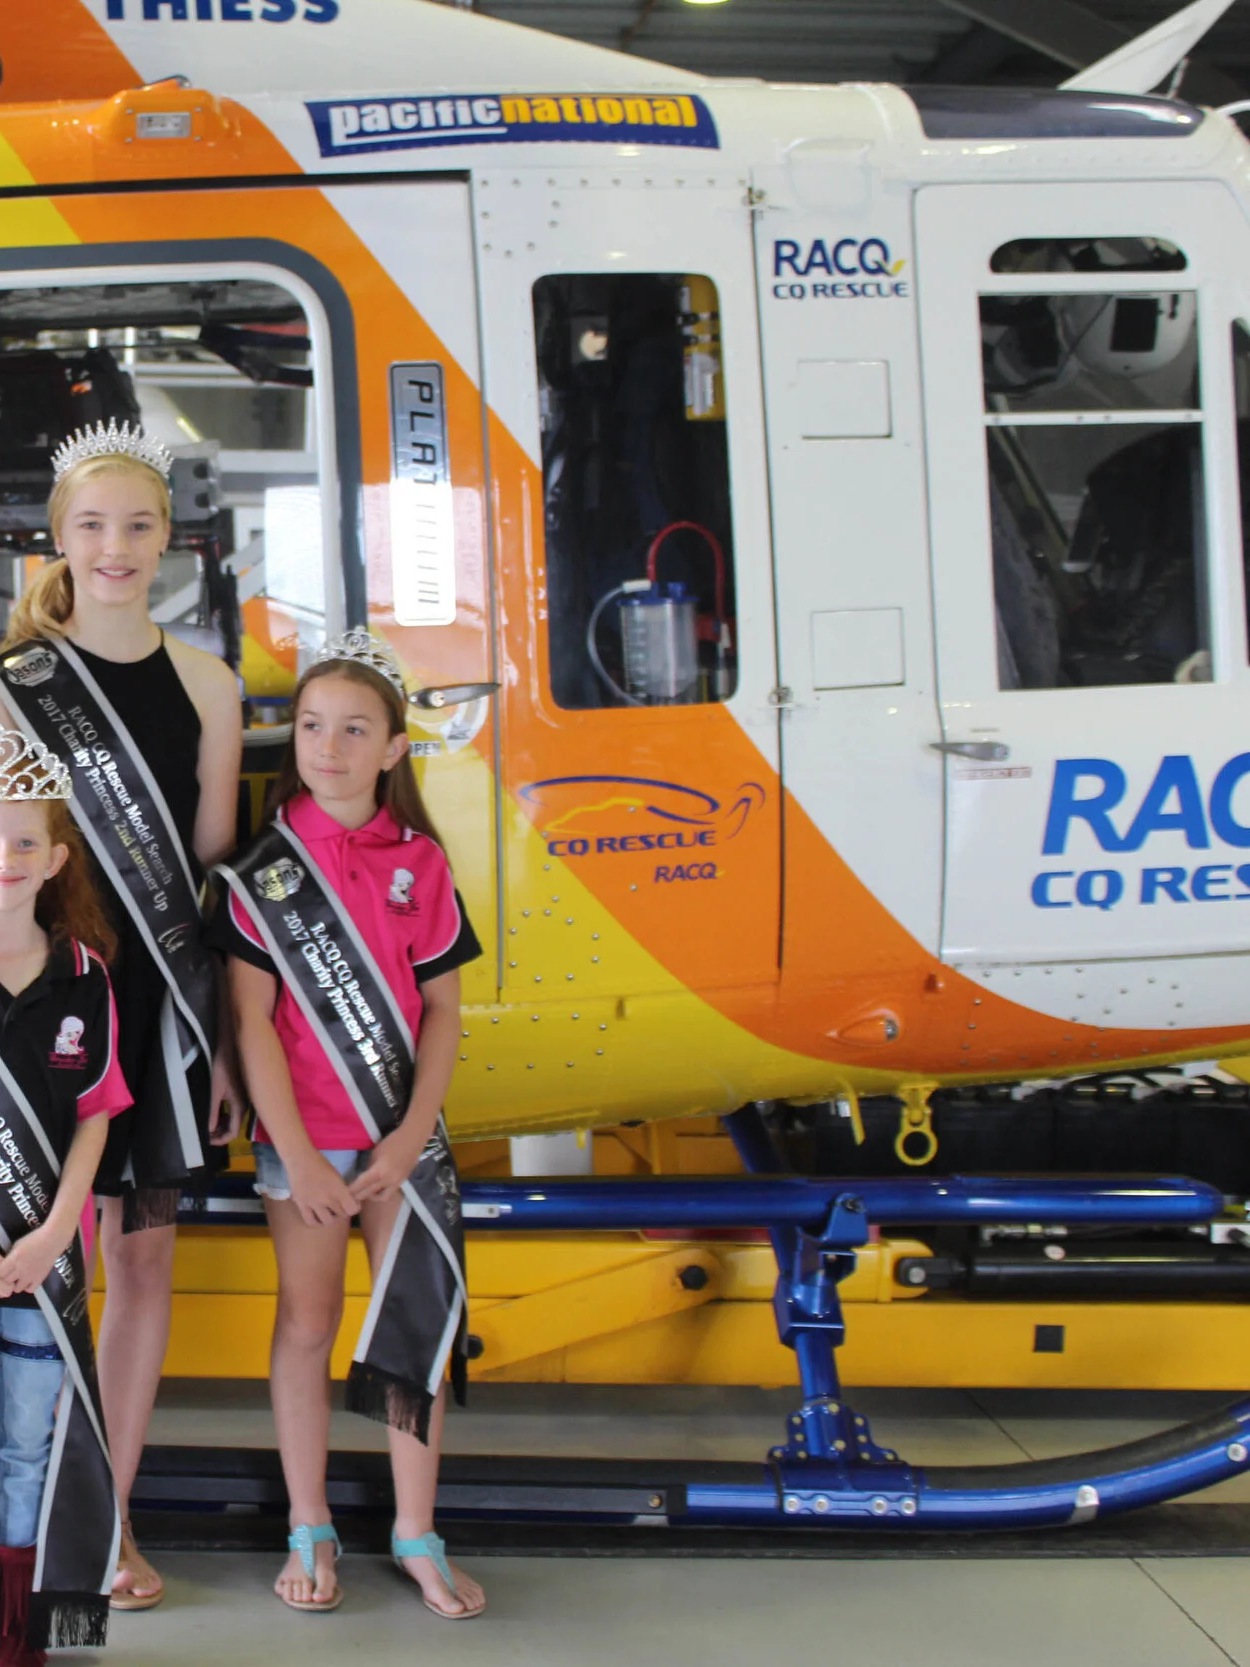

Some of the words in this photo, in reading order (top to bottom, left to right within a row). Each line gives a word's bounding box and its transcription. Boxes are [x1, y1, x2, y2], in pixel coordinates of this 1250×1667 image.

[773, 238, 891, 277] RACQ
[773, 283, 805, 300] CQ
[813, 280, 909, 299] RESCUE
[37, 694, 67, 722] 2017
[58, 723, 94, 768] Charity
[85, 767, 121, 822] Princess
[114, 821, 136, 848] 2nd
[129, 847, 160, 891] Runner
[153, 891, 169, 912] Up
[67, 705, 99, 744] RACQ
[92, 742, 112, 766] CQ
[102, 760, 134, 807] Rescue
[124, 803, 155, 844] Model
[147, 843, 174, 886] Search
[547, 838, 590, 857] CQ
[597, 831, 717, 853] RESCUE
[654, 862, 718, 884] RACQ
[1030, 869, 1124, 911] CQ
[282, 910, 311, 942] 2017
[301, 941, 335, 989] Charity
[326, 987, 366, 1043] Princess
[309, 921, 343, 964] RACQ
[334, 963, 354, 986] CQ
[344, 980, 377, 1026] Rescue
[24, 1172, 50, 1214] Mode
